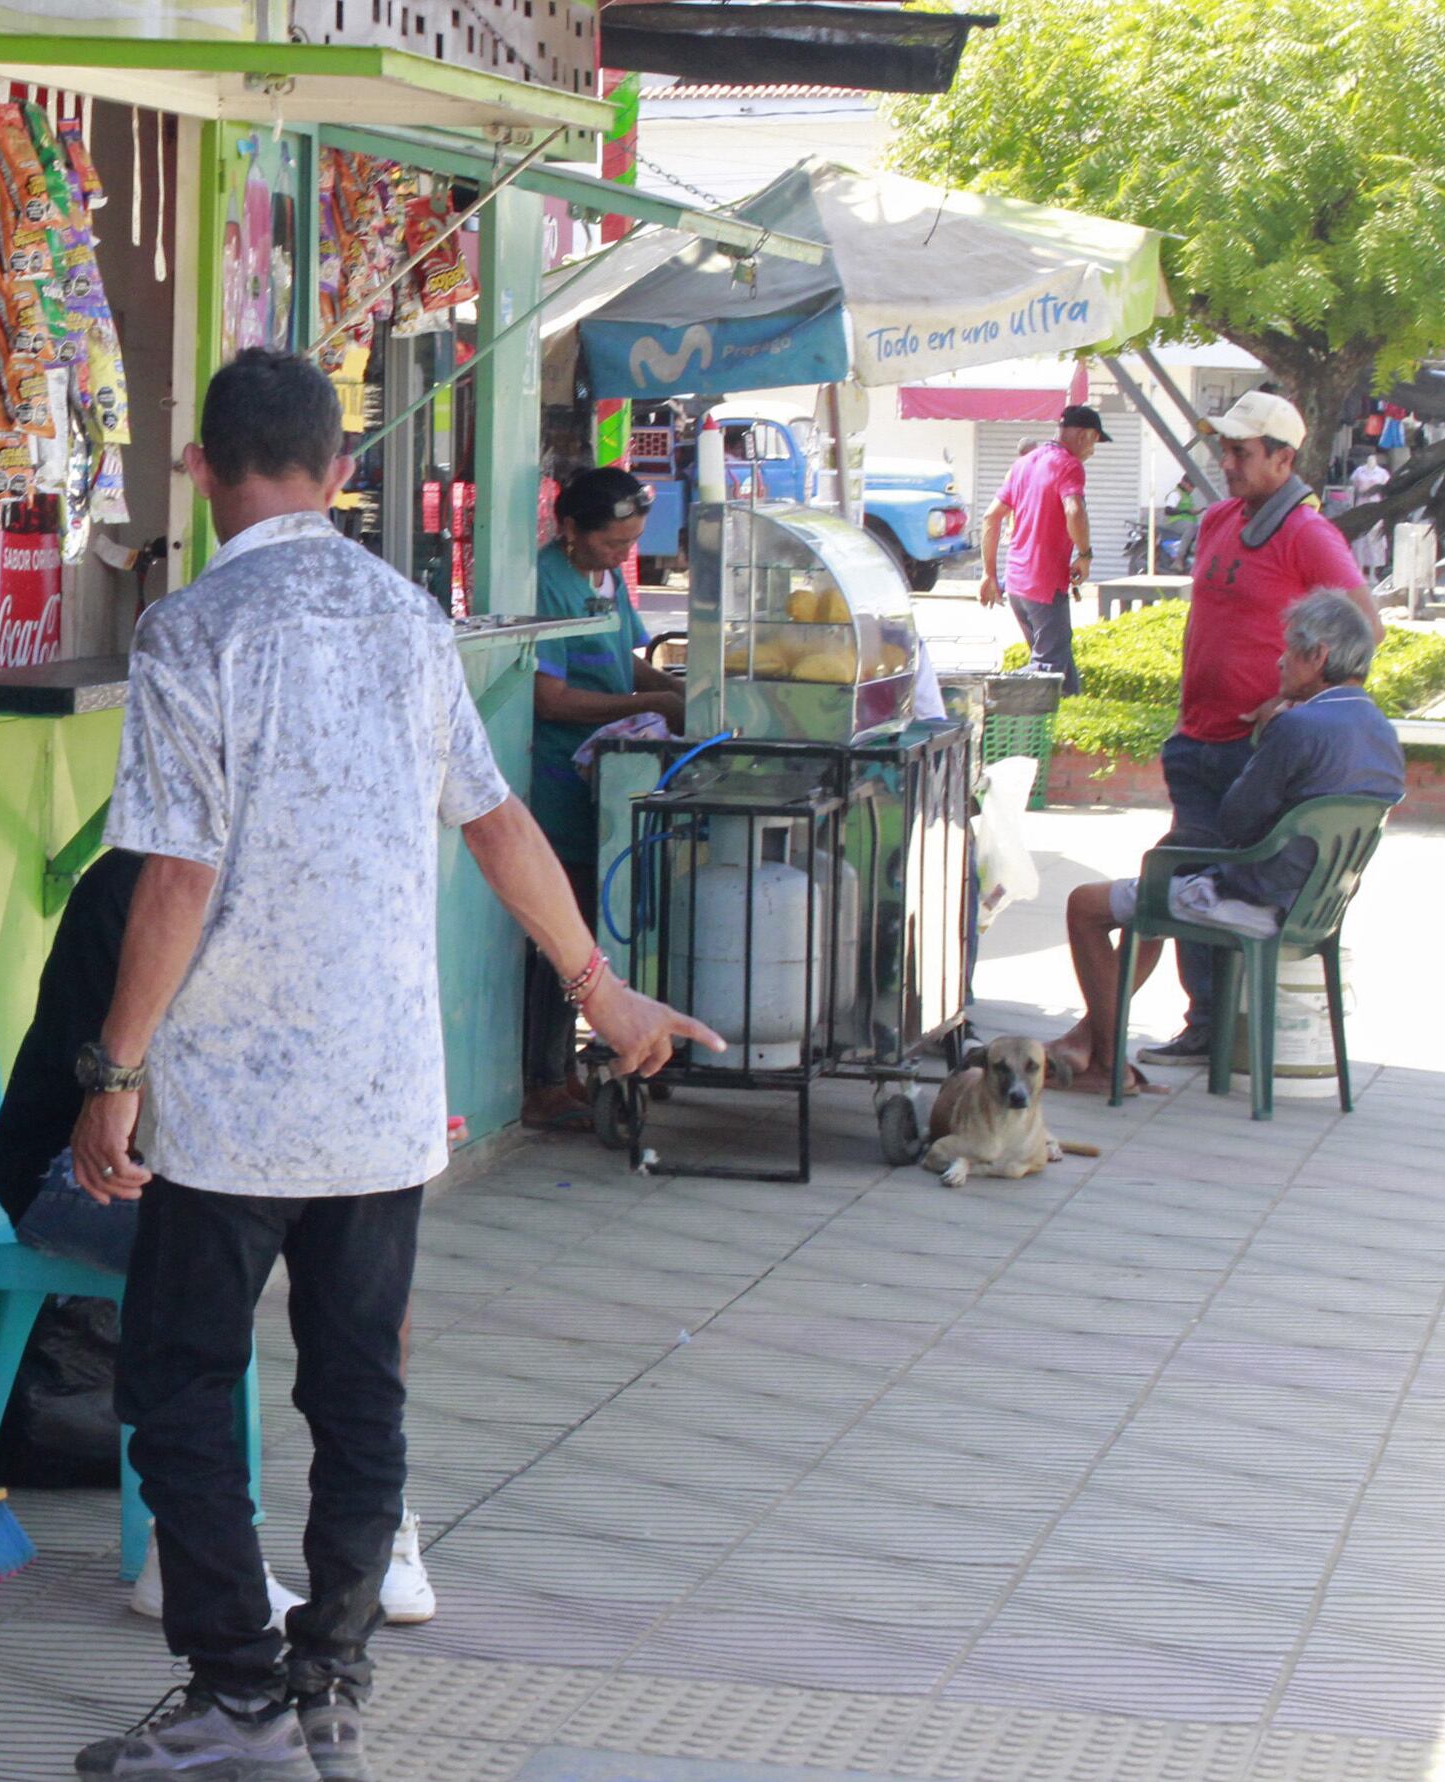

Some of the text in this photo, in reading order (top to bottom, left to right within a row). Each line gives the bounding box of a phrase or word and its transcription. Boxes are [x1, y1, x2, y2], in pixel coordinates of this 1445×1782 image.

[867, 293, 1090, 361] Todo en uno ultra
[3, 547, 32, 570] SABOR
